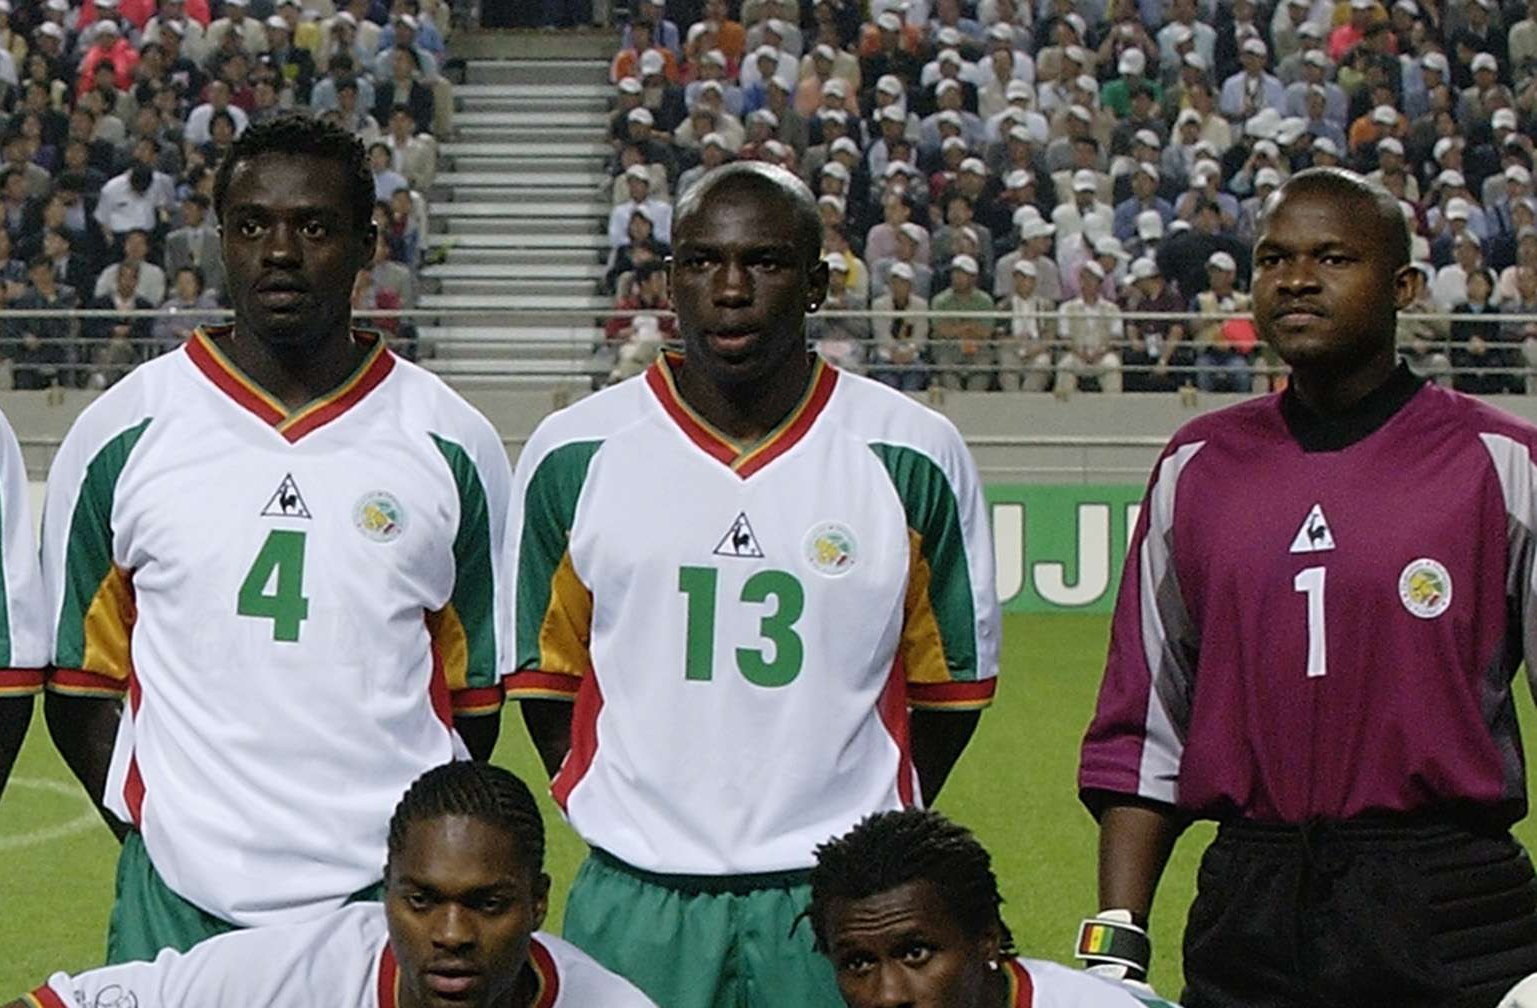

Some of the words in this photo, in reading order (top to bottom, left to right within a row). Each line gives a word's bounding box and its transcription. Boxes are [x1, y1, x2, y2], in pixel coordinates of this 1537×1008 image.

[237, 529, 309, 642] 4
[678, 566, 805, 688] 13
[1294, 567, 1327, 677] 1
